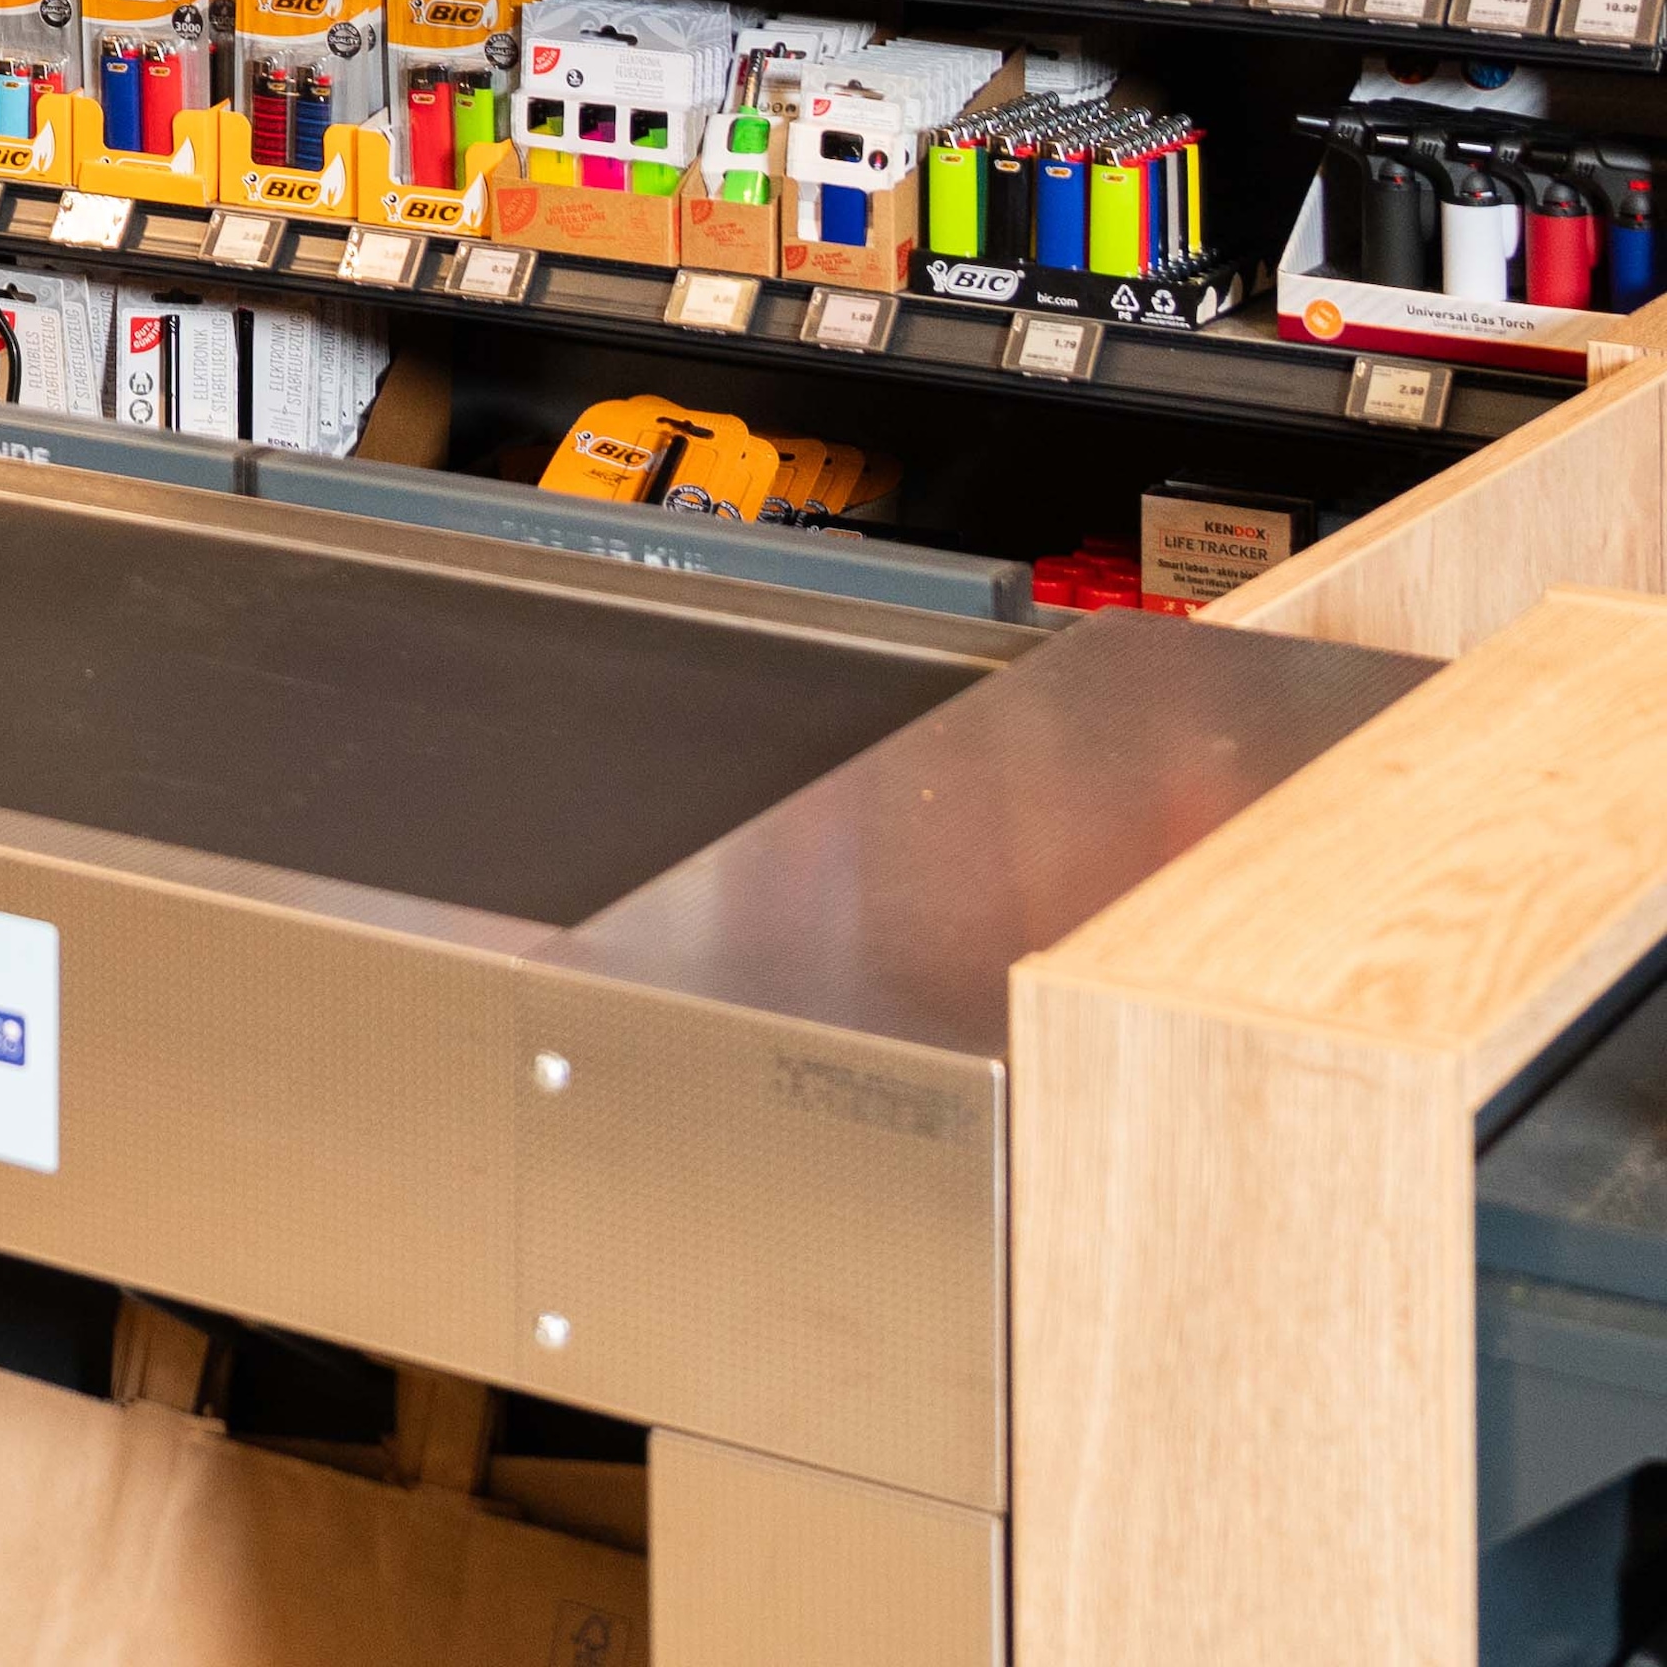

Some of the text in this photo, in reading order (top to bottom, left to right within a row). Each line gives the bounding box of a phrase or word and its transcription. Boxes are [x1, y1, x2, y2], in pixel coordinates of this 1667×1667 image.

[1037, 294, 1079, 308] bic.com
[1405, 305, 1535, 331] Universal Gas Torch
[1205, 520, 1266, 540] KENDOX
[1163, 534, 1268, 562] LIFE TRACKER
